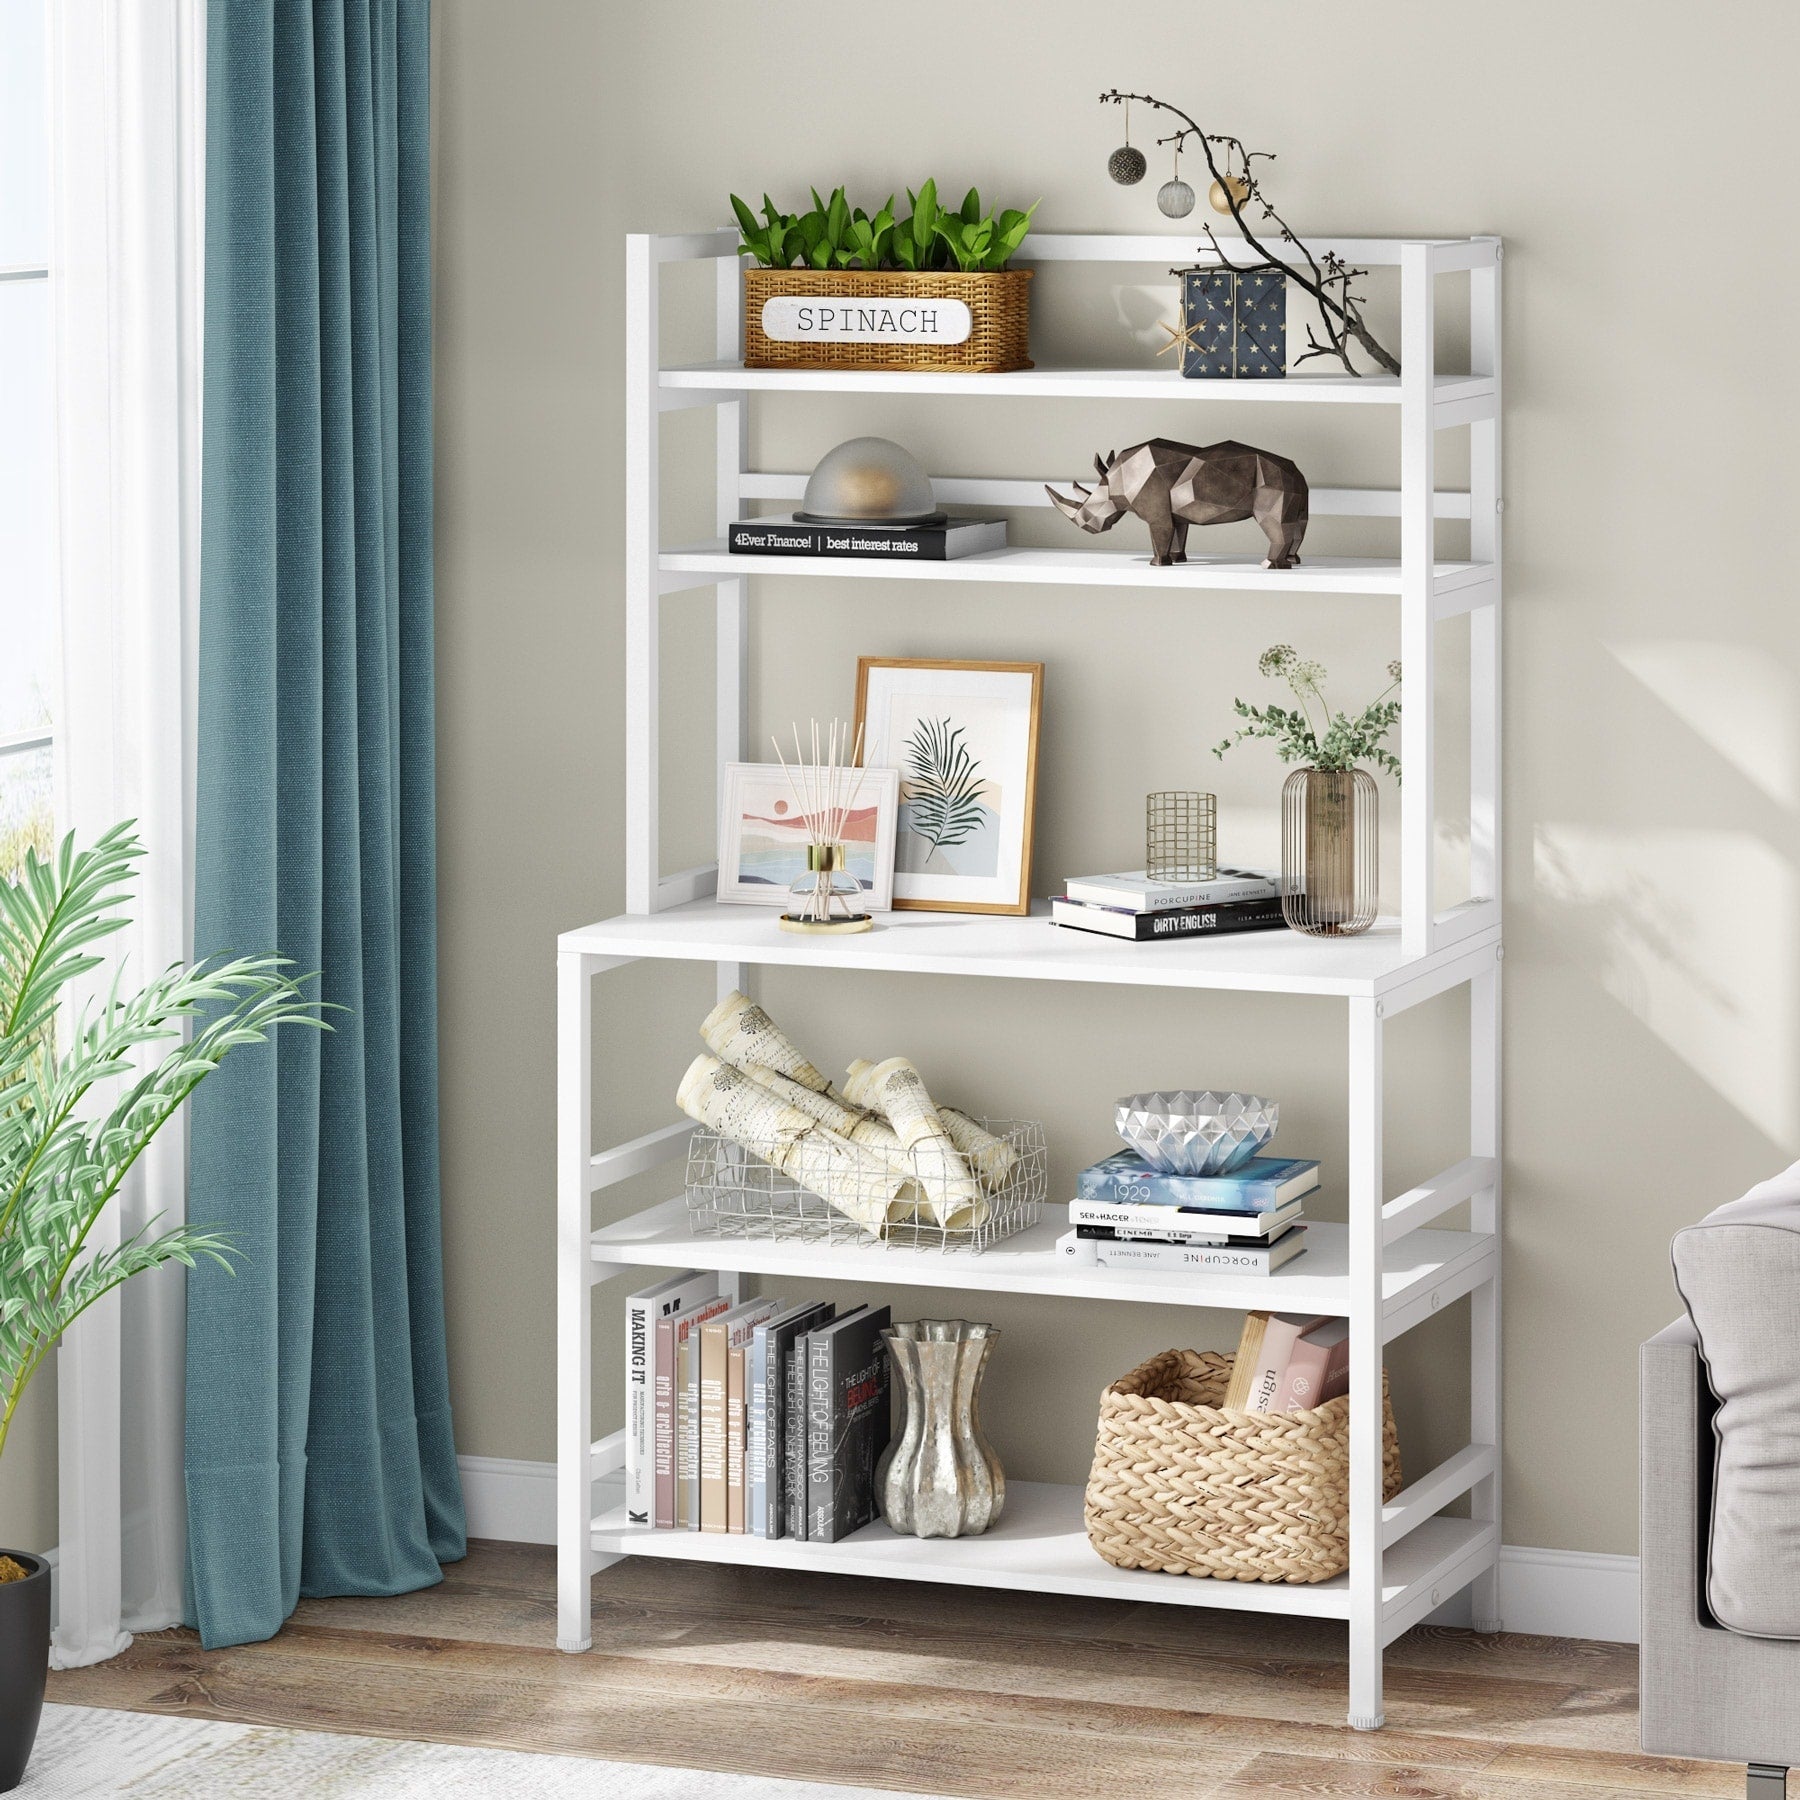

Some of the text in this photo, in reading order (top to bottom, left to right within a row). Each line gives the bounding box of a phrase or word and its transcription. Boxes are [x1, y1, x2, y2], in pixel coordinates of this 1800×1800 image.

[797, 307, 938, 333] SPINACH
[734, 532, 919, 552] 4Ever Finance! best interest rates
[1154, 893, 1211, 905] PORCUPINE
[1153, 913, 1217, 933] DIRTY ENGLISH
[1113, 1184, 1151, 1202] 1929
[1109, 1250, 1141, 1258] BENNETT
[1183, 1253, 1258, 1267] PORCUPINE
[631, 1308, 646, 1385] MAKING IT
[787, 1360, 796, 1380] THE
[656, 1376, 672, 1397] arts
[687, 1382, 699, 1403] arts
[700, 1379, 726, 1401] arts
[728, 1398, 743, 1417] arts
[767, 1337, 776, 1468] THE LIGHT OF PARIS
[787, 1382, 796, 1413] LIGHT
[797, 1398, 804, 1414] OF
[812, 1340, 829, 1483] THE LIGHT OF BEIJING
[656, 1412, 674, 1475] architecture
[687, 1419, 700, 1480] architecture
[700, 1416, 727, 1480] architecture
[728, 1431, 744, 1487] architecture
[796, 1439, 804, 1500] FRANCISCO
